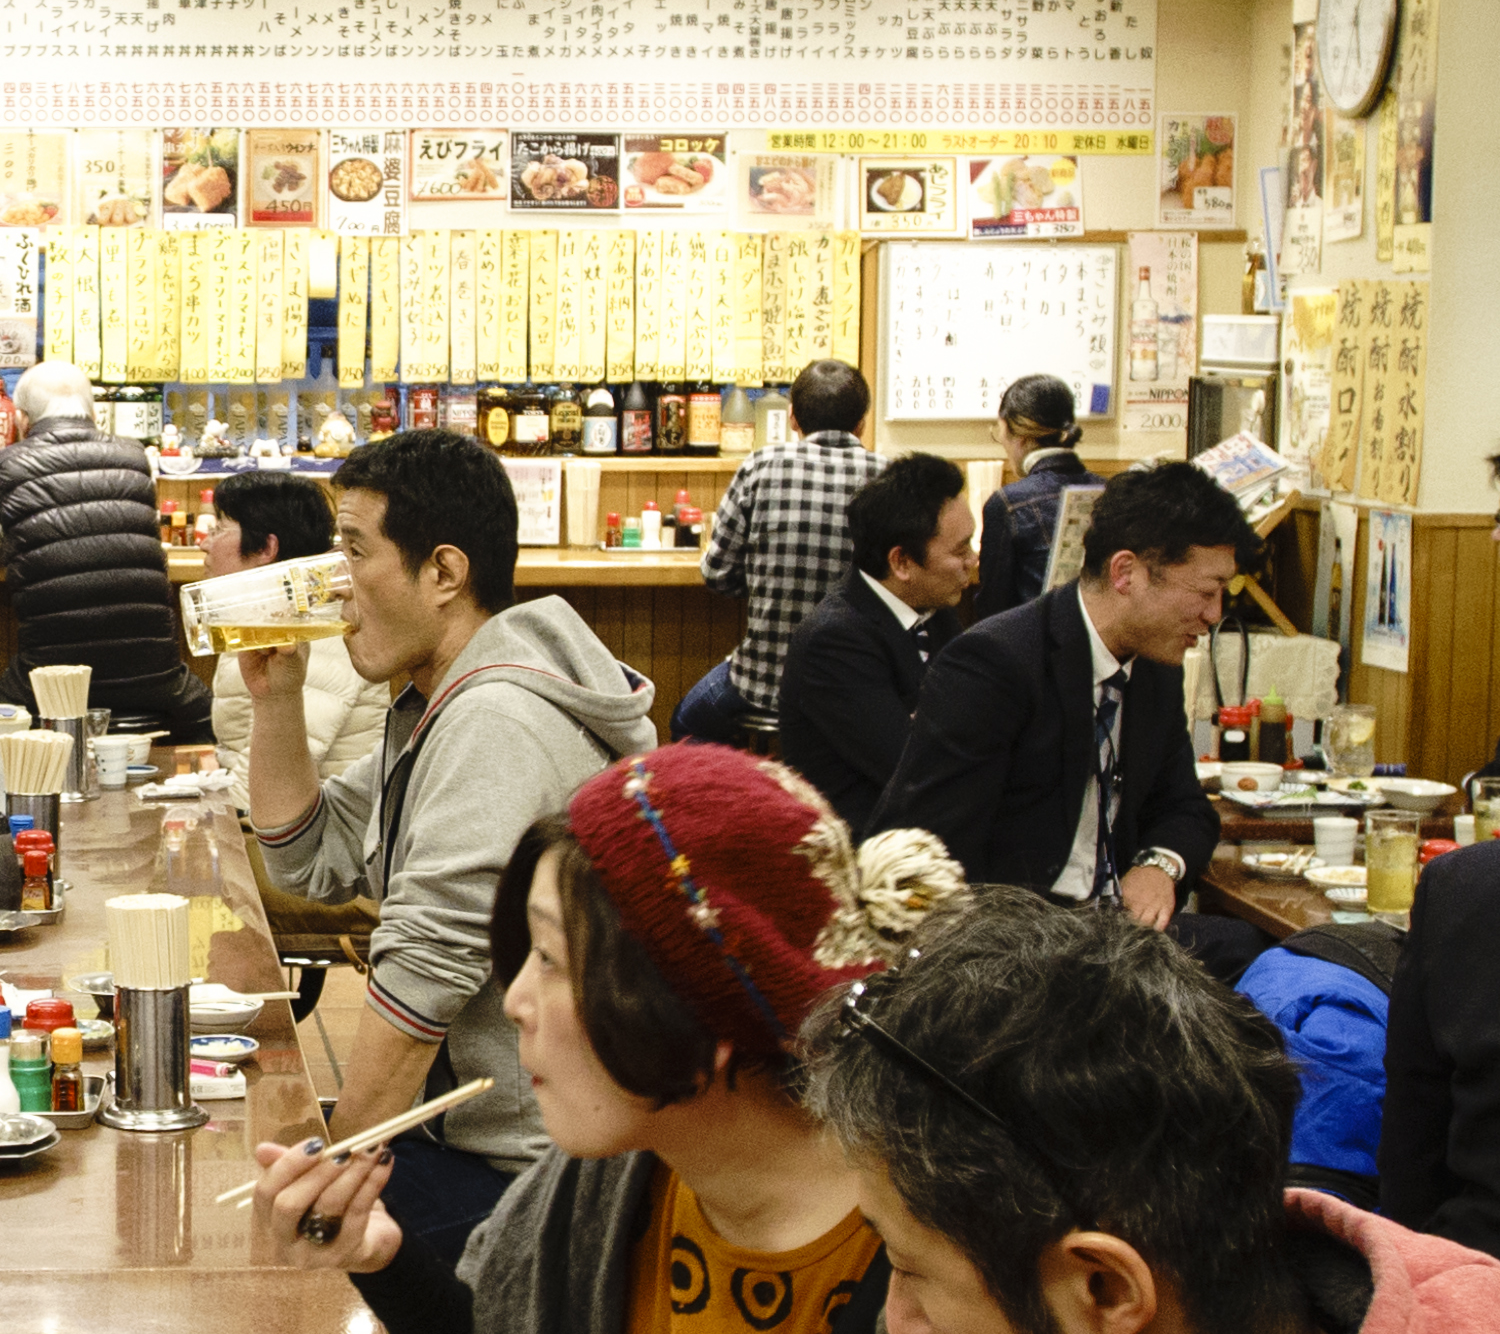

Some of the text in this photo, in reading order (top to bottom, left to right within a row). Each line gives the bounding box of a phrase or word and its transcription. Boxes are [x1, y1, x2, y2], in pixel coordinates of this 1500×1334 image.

[331, 134, 380, 156] 三ちゃん特製
[418, 138, 504, 162] えびフライ
[516, 141, 590, 157] たこから揚げ
[659, 138, 720, 153] コロッケ
[770, 134, 817, 149] 営業時間
[1072, 135, 1106, 150] 定休日
[1116, 135, 1150, 150] 水曜日
[382, 130, 402, 235] 麻婆豆腐
[1148, 388, 1189, 401] NIPPON
